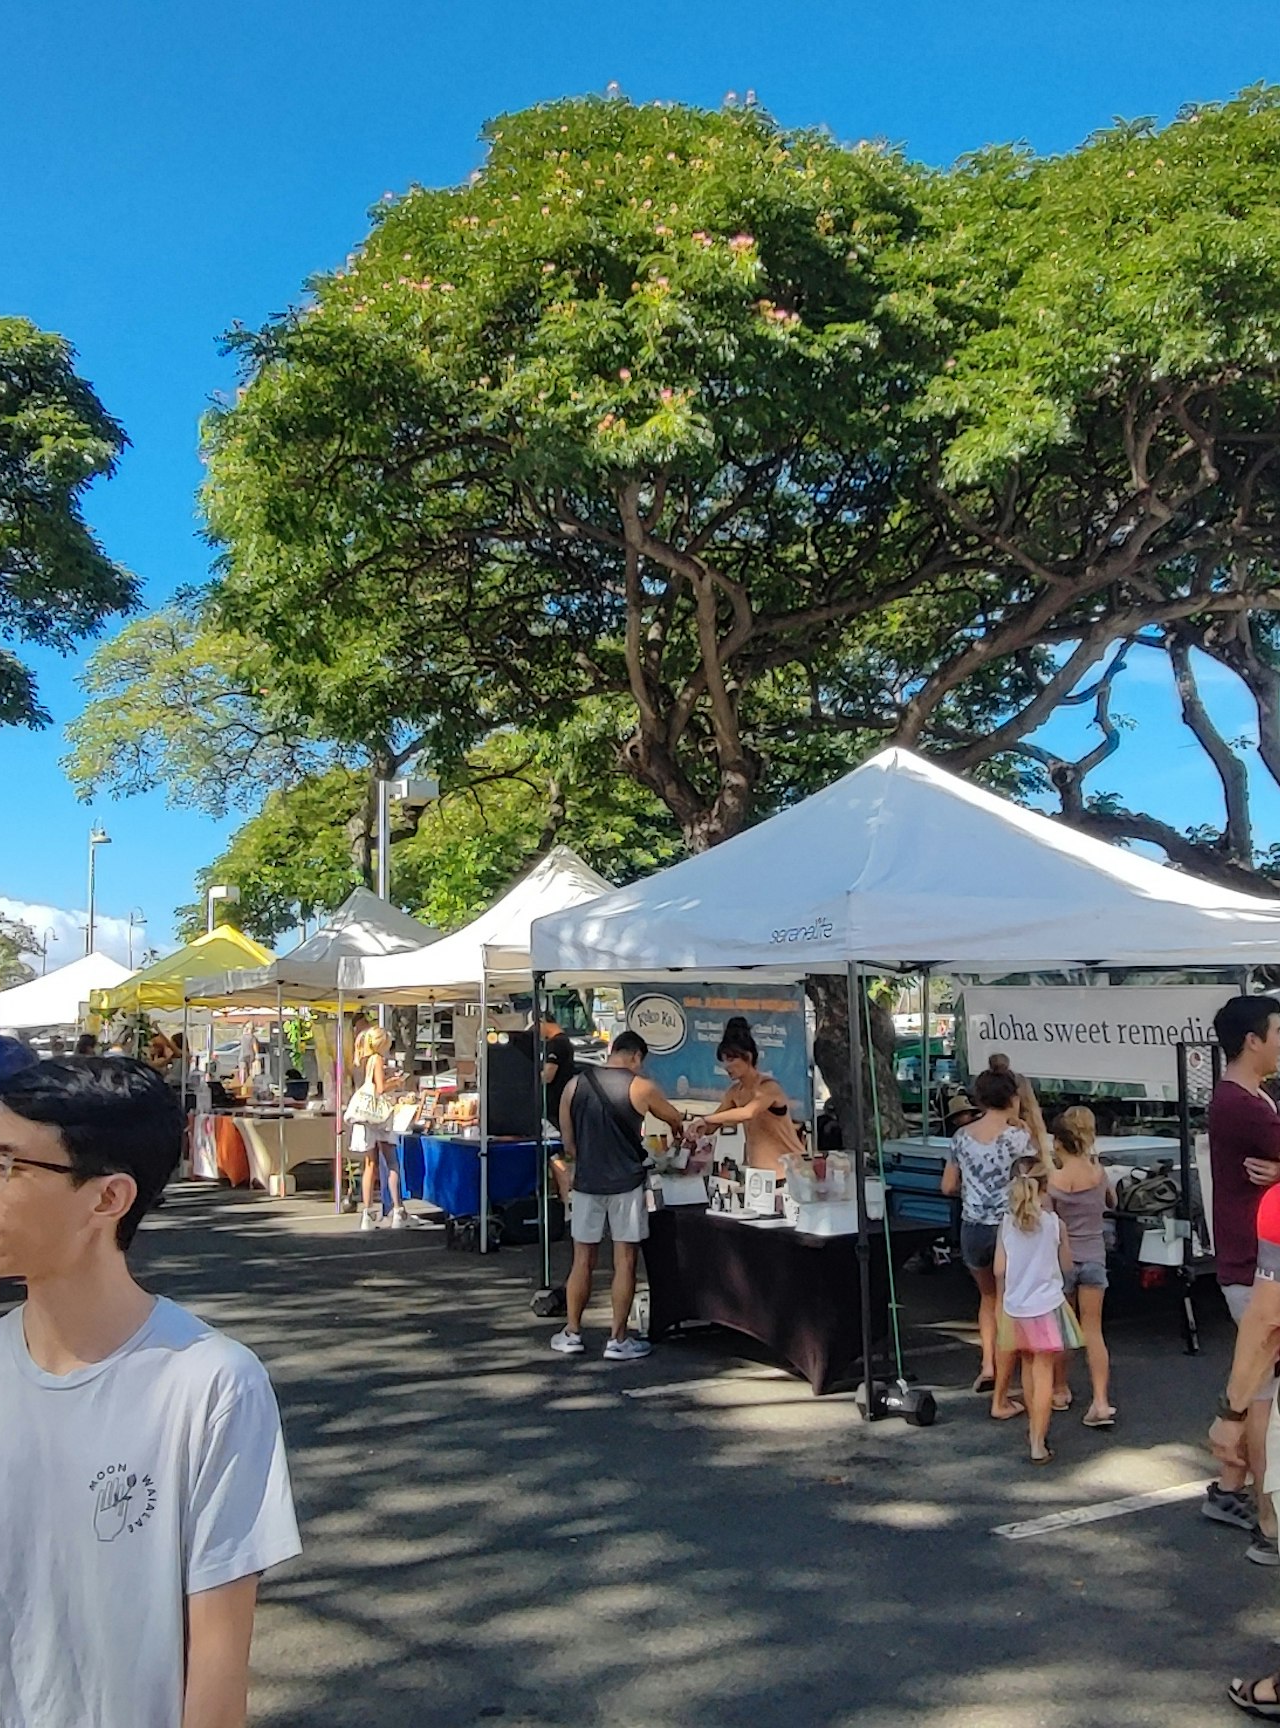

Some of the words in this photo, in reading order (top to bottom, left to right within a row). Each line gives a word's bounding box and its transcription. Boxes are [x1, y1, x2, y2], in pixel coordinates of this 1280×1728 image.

[979, 1013, 1038, 1041] aloha
[1044, 1020, 1111, 1044] sweet
[1117, 1017, 1219, 1046] remedie
[89, 1463, 127, 1491] MOON
[127, 1474, 157, 1533] WAIALAE
